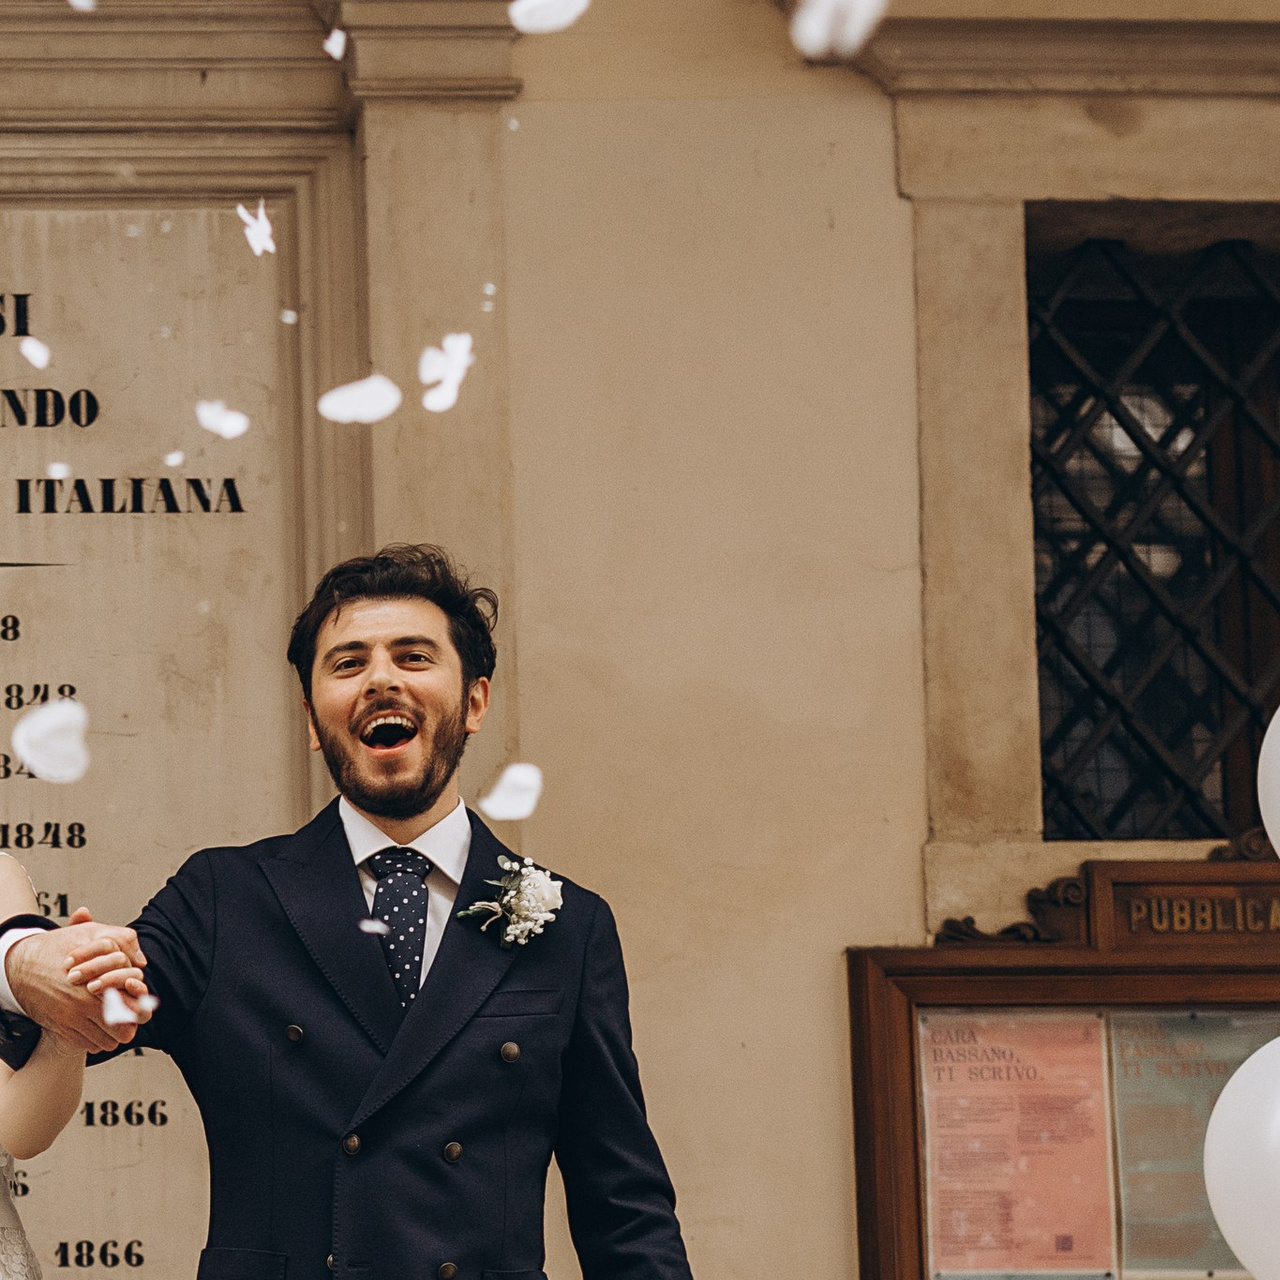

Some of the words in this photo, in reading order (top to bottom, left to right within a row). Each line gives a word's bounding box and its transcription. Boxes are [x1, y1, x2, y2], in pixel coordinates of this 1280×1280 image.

[15, 477, 246, 514] ITALIANA
[36, 892, 70, 918] 61
[931, 1028, 978, 1045] CARA
[933, 1066, 955, 1082] TI
[80, 1100, 169, 1128] 1866
[54, 1240, 146, 1268] 1866
